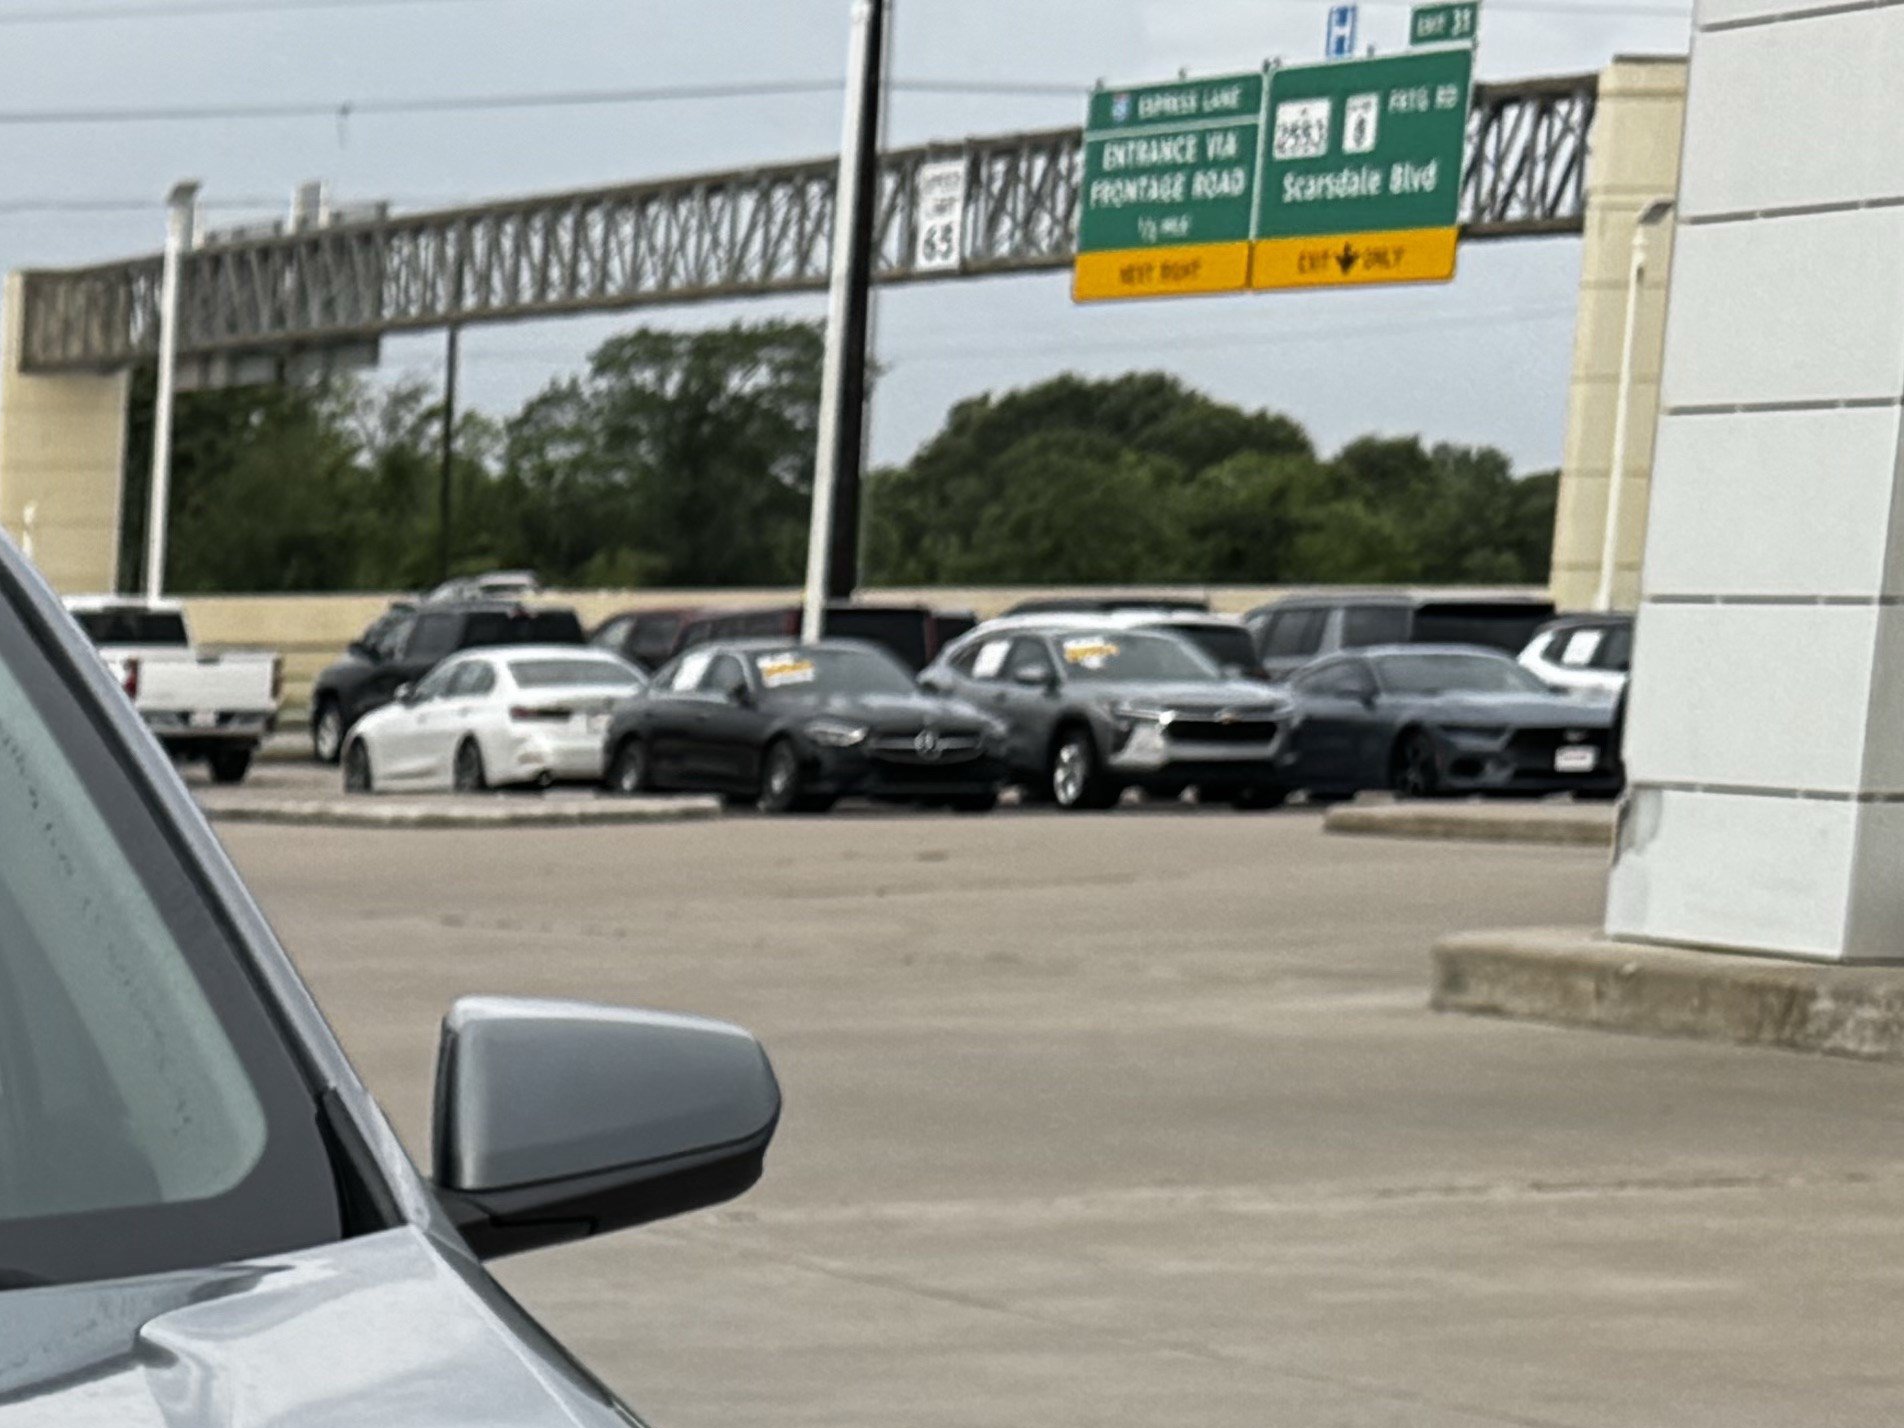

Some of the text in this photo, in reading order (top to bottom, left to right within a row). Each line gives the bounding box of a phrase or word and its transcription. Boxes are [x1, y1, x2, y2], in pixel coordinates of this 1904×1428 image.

[1137, 90, 1198, 119] EXPRESS
[1202, 83, 1242, 112] LANE
[1435, 83, 1458, 110] RD
[1102, 130, 1238, 170] ENTRANCE VIA
[1090, 167, 1246, 209] FRONTAGE ROAD
[1283, 157, 1438, 203] Scarsdale Blvd
[923, 223, 954, 262] 65
[1297, 245, 1406, 274] EXIT ONLY
